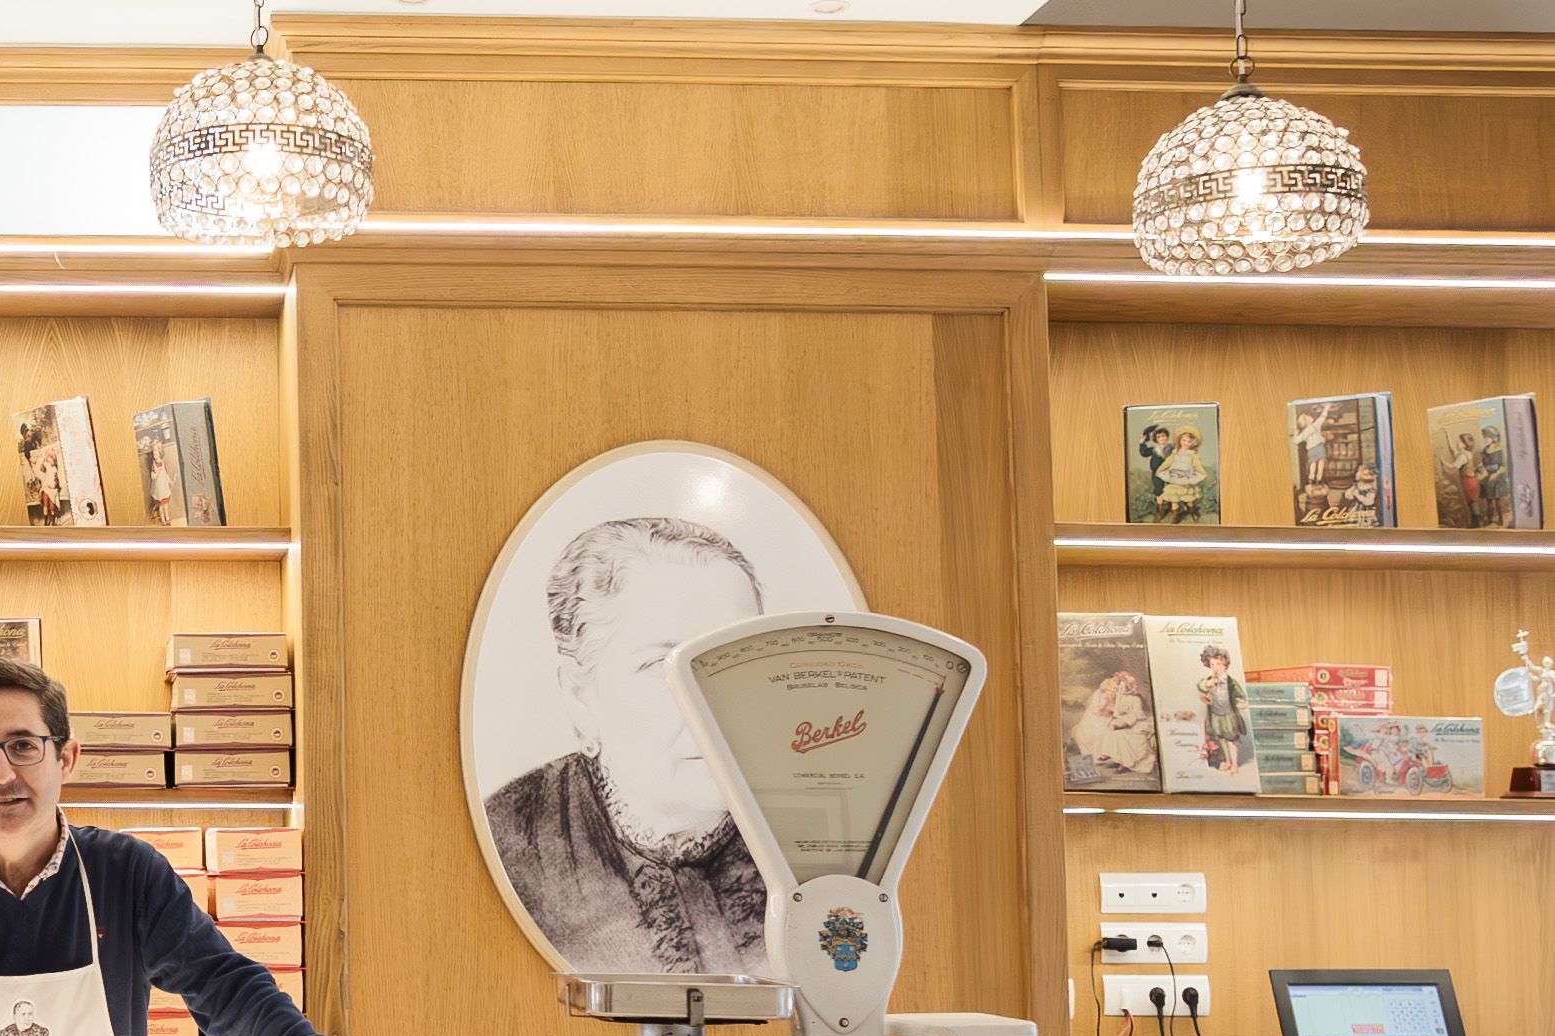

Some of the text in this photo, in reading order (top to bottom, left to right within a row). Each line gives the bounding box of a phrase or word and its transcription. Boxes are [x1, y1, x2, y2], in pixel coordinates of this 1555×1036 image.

[946, 660, 954, 670] 0
[768, 673, 790, 684] VAN
[844, 671, 885, 685] PATENT
[791, 709, 867, 753] Berkel
